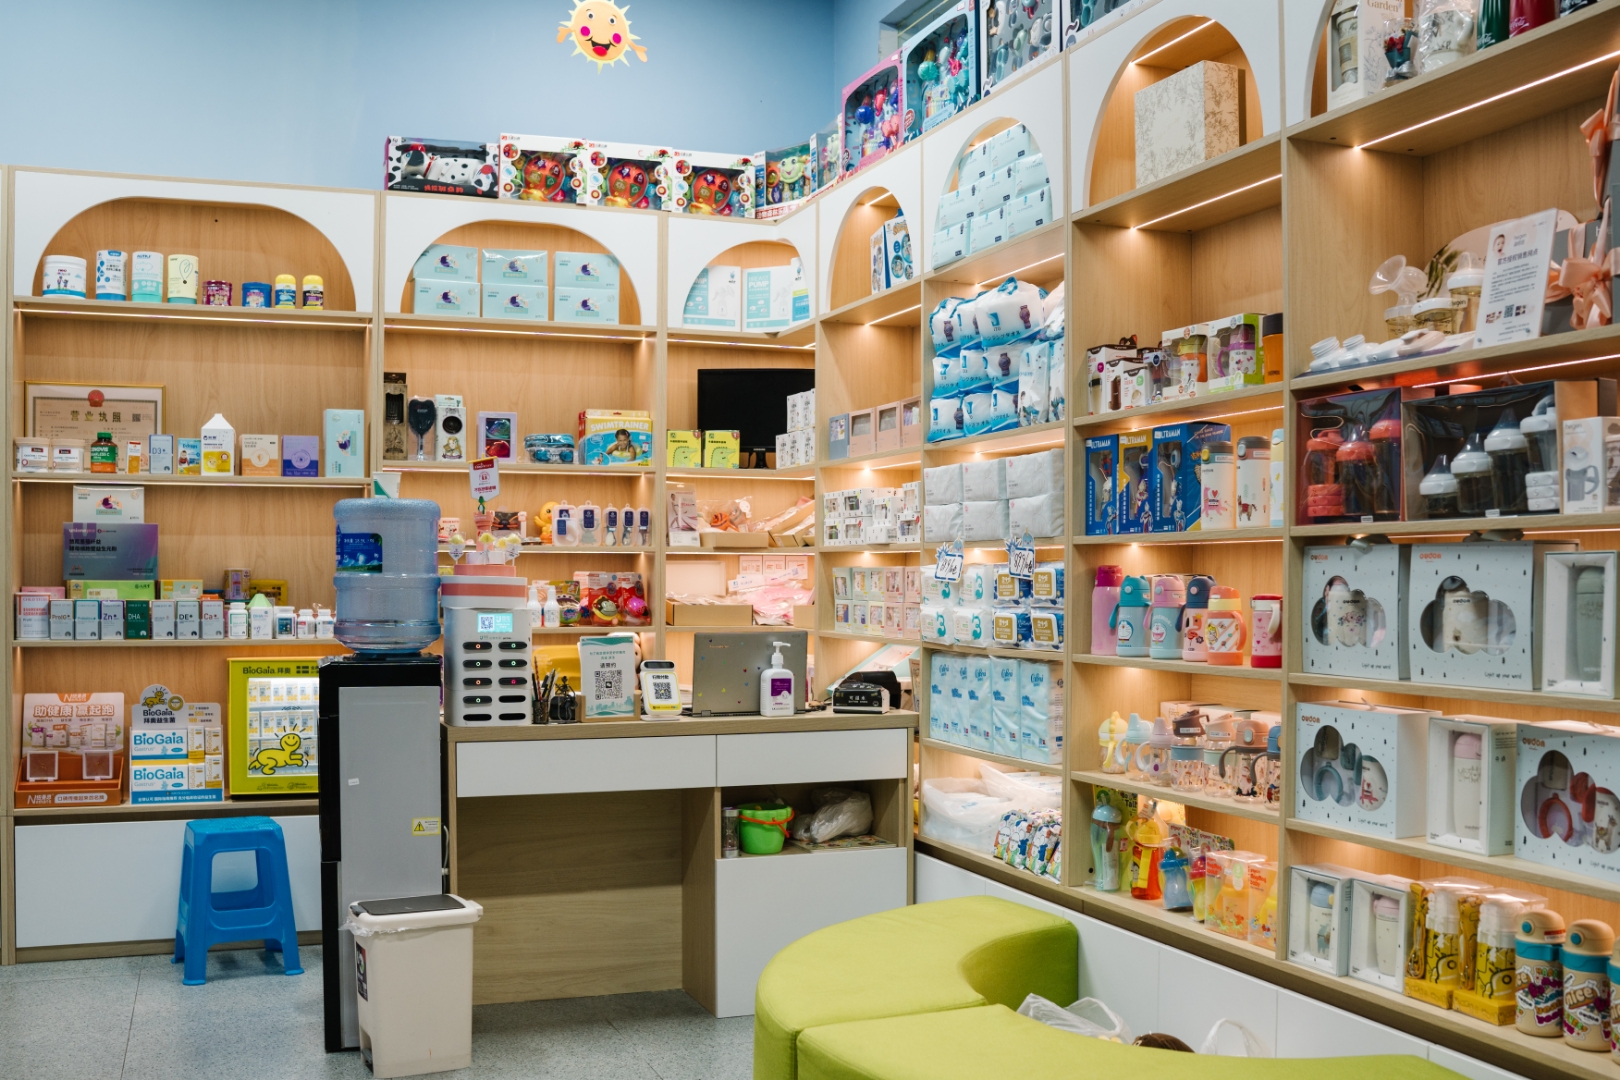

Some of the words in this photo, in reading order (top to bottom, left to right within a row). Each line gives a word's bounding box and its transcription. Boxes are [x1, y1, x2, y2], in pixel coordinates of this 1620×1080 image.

[1367, 0, 1398, 12] Garden
[70, 410, 121, 422] 营业执照
[590, 421, 649, 431] SWIMTRAINER
[1160, 428, 1180, 438] LTRAMAN
[1125, 435, 1146, 444] LTRAMAN
[34, 705, 73, 717] 助健康
[76, 704, 114, 717] 赢起跑
[134, 732, 184, 745] BioGaia
[1522, 737, 1545, 747] oudon
[134, 767, 184, 780] BioGaia
[1565, 987, 1592, 1006] nice
